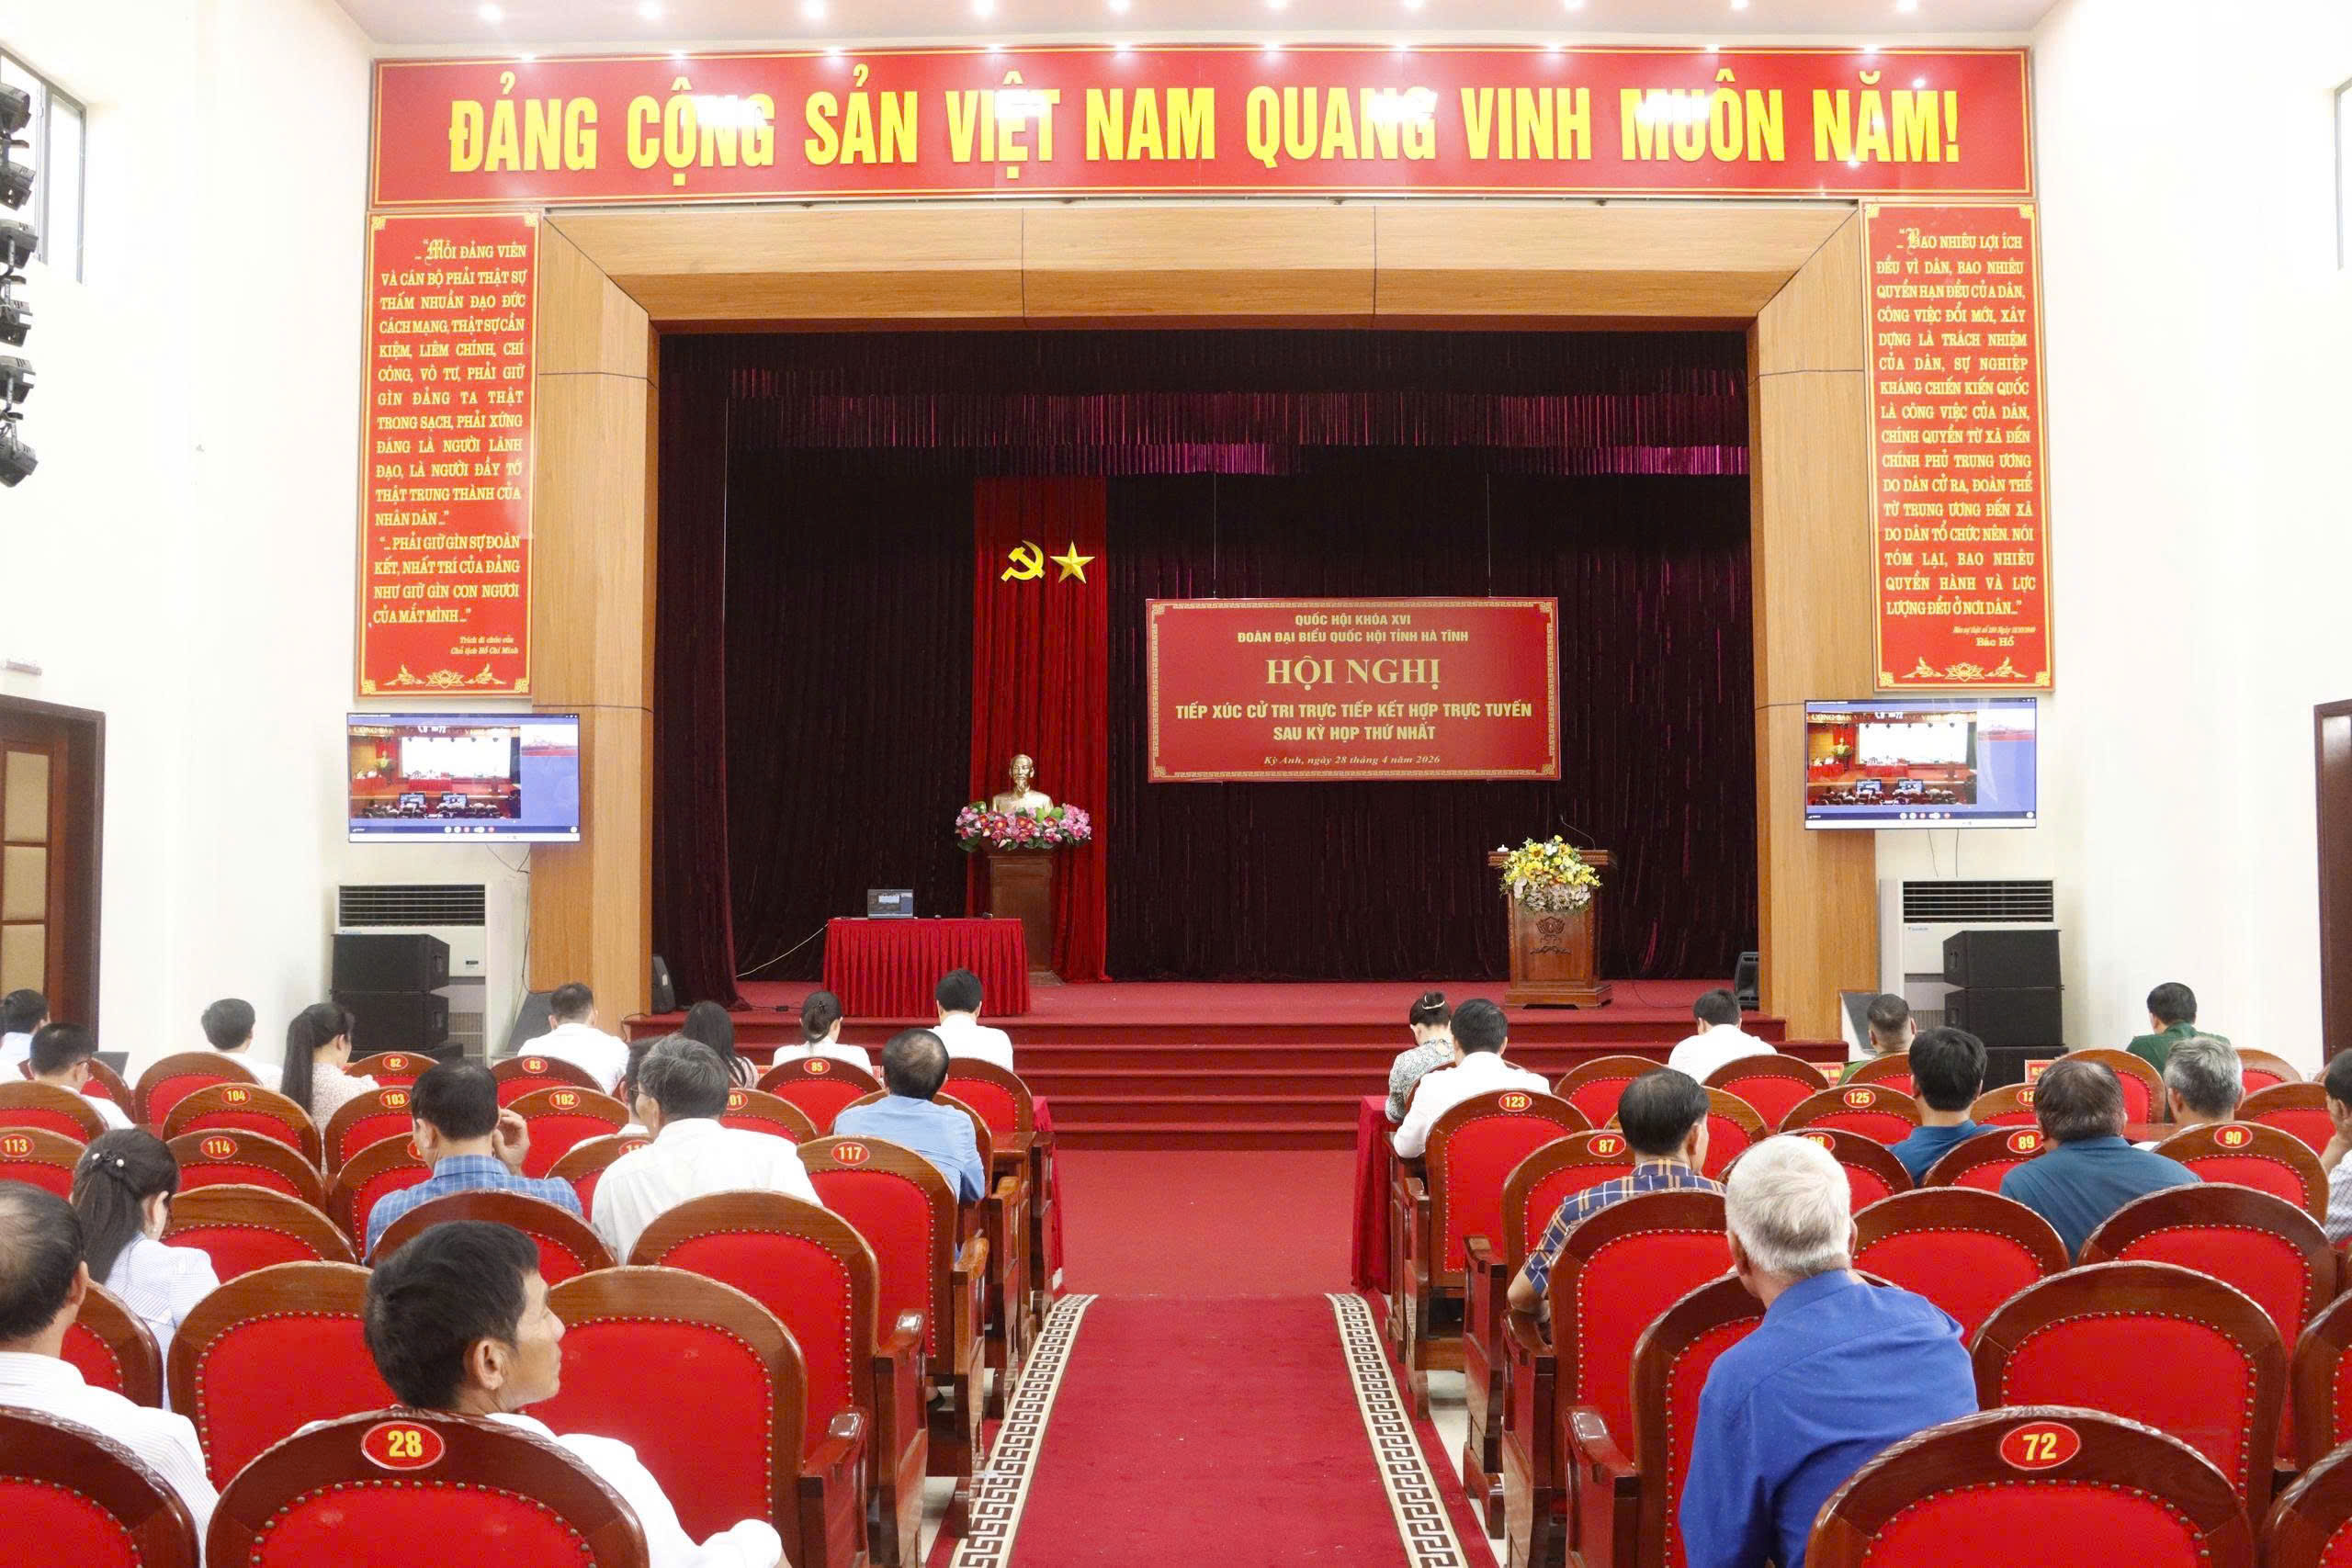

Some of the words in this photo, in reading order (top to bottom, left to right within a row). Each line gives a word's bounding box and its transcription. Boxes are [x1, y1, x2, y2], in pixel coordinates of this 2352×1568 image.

[449, 71, 597, 173] ĐẢNG
[627, 75, 775, 186] CỘNG
[805, 64, 919, 167] SẢN
[945, 71, 1060, 179] VIỆT
[1087, 87, 1214, 162] NAM
[1246, 85, 1438, 168] QUANG
[1461, 87, 1592, 161] VINH
[1623, 67, 1784, 163] MUÔN
[1814, 71, 1961, 163] NĂM!
[1876, 255, 1900, 274] ĐỀU
[1905, 257, 1918, 274] VÌ
[1925, 257, 1952, 275] DÂN,
[1958, 261, 1981, 274] BAO
[1987, 257, 2024, 274] NHIÊU
[381, 270, 397, 286] VÀ
[400, 269, 424, 286] CÁN
[427, 269, 444, 288] BỘ
[447, 266, 475, 285] PHẢI
[478, 267, 509, 287] THẬT
[511, 269, 527, 286] SỰ
[380, 291, 414, 310] THẤM
[421, 289, 463, 309] NHUẦN
[470, 295, 495, 310] ĐẠO
[503, 291, 526, 308] ĐỨC
[420, 341, 448, 356] LIÊM
[456, 340, 496, 356] CHÍNH,
[503, 339, 524, 355] CHÍ
[1879, 332, 1911, 349] DỰNG
[1918, 331, 1934, 345] LÀ
[1941, 331, 1980, 346] TRÁCH
[1988, 330, 2027, 349] NHIỆM
[379, 365, 413, 382] CÔNG,
[421, 365, 436, 380] VÔ
[468, 361, 496, 379] PHẢI
[503, 364, 525, 379] GIỮ
[1879, 352, 1905, 370] CỦA
[1915, 354, 1944, 371] DÂN,
[1954, 355, 1971, 373] SỰ
[1980, 354, 2028, 373] NGHIỆP
[1881, 378, 1922, 394] KHÁNG
[1925, 376, 1962, 394] CHIẾN
[1964, 376, 1994, 394] KIẾN
[1997, 377, 2029, 396] QUỐC
[378, 389, 402, 406] GÌN
[413, 387, 450, 404] ĐẢNG
[460, 391, 478, 404] TA
[488, 387, 524, 406] THẬT
[1882, 402, 1896, 419] LÀ
[1902, 402, 1934, 419] CÔNG
[1940, 402, 1967, 422] VIỆC
[1973, 400, 1996, 419] CỦA
[2002, 402, 2030, 421] DÂN,
[377, 416, 418, 430] TRONG
[420, 415, 453, 432] SẠCH,
[457, 410, 485, 428] PHẢI
[490, 412, 523, 427] XỨNG
[1882, 426, 1918, 443] CHÍNH
[1922, 423, 1963, 444] QUYỀN
[1967, 427, 1983, 444] TỪ
[2007, 424, 2030, 443] ĐẾN
[1882, 450, 1919, 468] CHÍNH
[1926, 449, 1948, 468] PHỦ
[1954, 455, 1994, 468] TRUNG
[1999, 453, 2031, 468] ƯƠNG
[376, 465, 403, 480] ĐẠO,
[410, 461, 424, 477] LÀ
[431, 460, 469, 477] NGƯỜI
[475, 457, 500, 476] ĐẦY
[375, 510, 410, 525] NHÂN
[375, 556, 400, 576] KẾT,
[402, 556, 439, 574] NHẤT
[437, 558, 458, 573] TRÍ
[459, 555, 483, 573] CỦA
[486, 554, 520, 573] ĐẢNG
[1884, 548, 1913, 566] TÓM
[1922, 553, 1948, 569] LẠI,
[1958, 552, 1984, 566] BAO
[1994, 548, 2034, 566] NHIÊU
[1885, 570, 1929, 591] QUYỀN
[1939, 573, 1976, 590] HÀNH
[1985, 573, 2003, 590] VÀ
[2013, 575, 2036, 592] LỰC
[374, 584, 401, 599] NHƯ
[402, 582, 424, 598] GIỮ
[427, 582, 449, 598] GÌN
[453, 585, 478, 598] CON
[1295, 612, 1328, 626] QUỐC
[1331, 613, 1351, 626] HỘI
[1355, 613, 1387, 625] KHÓA
[1392, 615, 1410, 625] XVI
[1238, 631, 1271, 642] ĐOÀN
[1275, 632, 1295, 644] ĐẠI
[1299, 628, 1326, 642] BIỂU
[1330, 628, 1362, 643] QUỐC
[1366, 630, 1385, 643] HỘI
[1421, 630, 1437, 641] HÀ
[1266, 656, 1333, 691] HỘI
[1346, 660, 1440, 690] NGHỊ
[1176, 702, 1207, 718] TIẾP
[1213, 703, 1241, 718] XÚC
[1247, 701, 1268, 717] CỬ
[1272, 705, 1294, 717] TRI
[1299, 703, 1336, 720] TRỰC
[1341, 700, 1373, 717] TIẾP
[1378, 700, 1404, 717] KẾT
[1409, 703, 1438, 720] HỢP
[1443, 703, 1480, 719] TRỰC
[1485, 700, 1532, 716] TUYẾN
[1273, 728, 1301, 740] SAU
[1306, 724, 1325, 739] KỲ
[1330, 727, 1359, 742] HỌP
[1364, 724, 1394, 739] THỨ
[1396, 722, 1435, 739] NHẤT
[1264, 757, 1277, 765] Kỳ
[1307, 756, 1331, 765] ngày
[1351, 757, 1378, 765] tháng
[1381, 755, 1389, 764] 4
[389, 1056, 401, 1068] 82
[529, 1060, 541, 1071] 83
[811, 1060, 823, 1072] 85
[227, 1089, 245, 1102] 104
[387, 1094, 405, 1107] 103
[555, 1094, 574, 1107] 102
[729, 1093, 742, 1106] 01
[1506, 1096, 1524, 1109] 123
[1851, 1091, 1870, 1103] 125
[2023, 1090, 2034, 1103] 12
[6, 1139, 28, 1153] 113
[1599, 1139, 1614, 1153] 87
[2018, 1133, 2035, 1147] 89
[2224, 1131, 2242, 1145] 90
[208, 1141, 231, 1155] 114
[839, 1147, 861, 1160] 117
[388, 1429, 424, 1459] 28
[2022, 1433, 2057, 1461] 72
